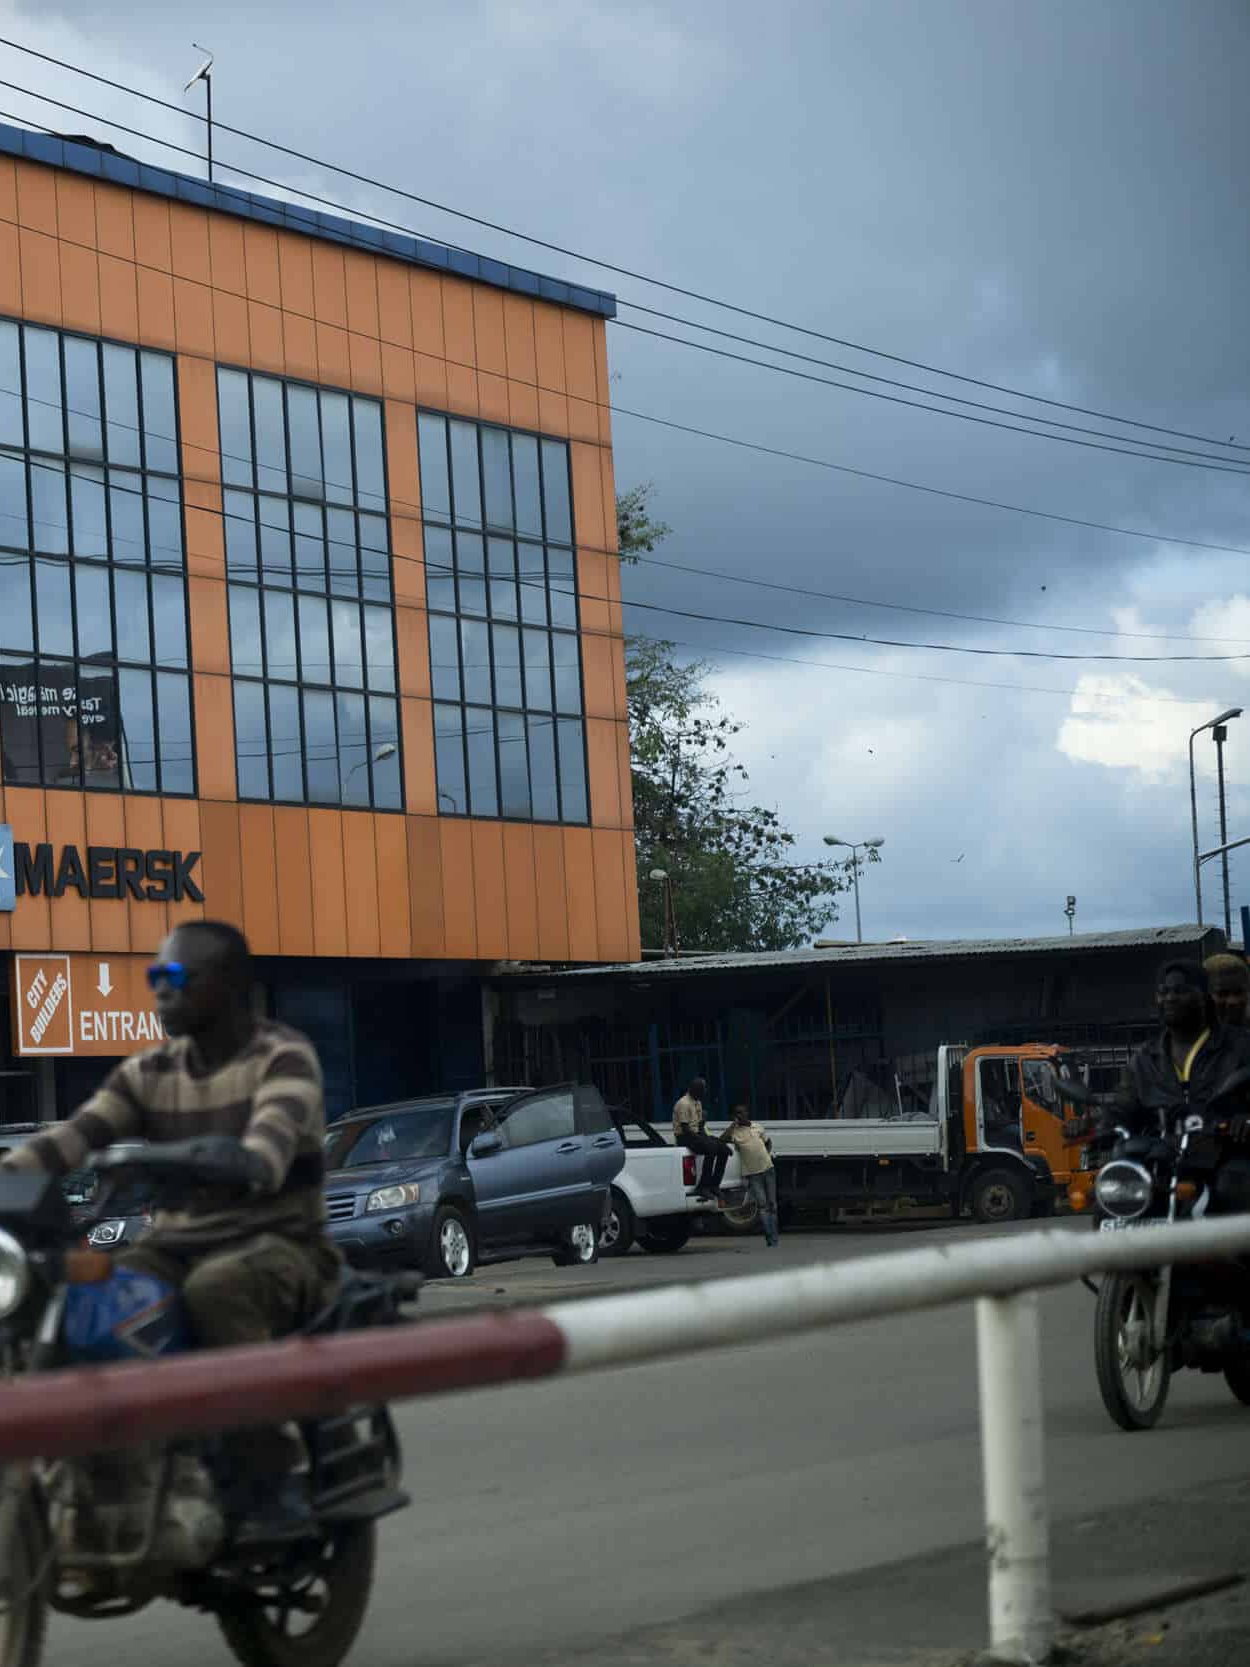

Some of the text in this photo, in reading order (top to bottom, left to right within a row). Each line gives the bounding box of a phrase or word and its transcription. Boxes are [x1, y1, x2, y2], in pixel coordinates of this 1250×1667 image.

[13, 842, 205, 903] MAERSK
[26, 968, 49, 1009] CITY
[29, 972, 68, 1044] BUILDERS
[80, 1011, 170, 1041] ENTRAN
